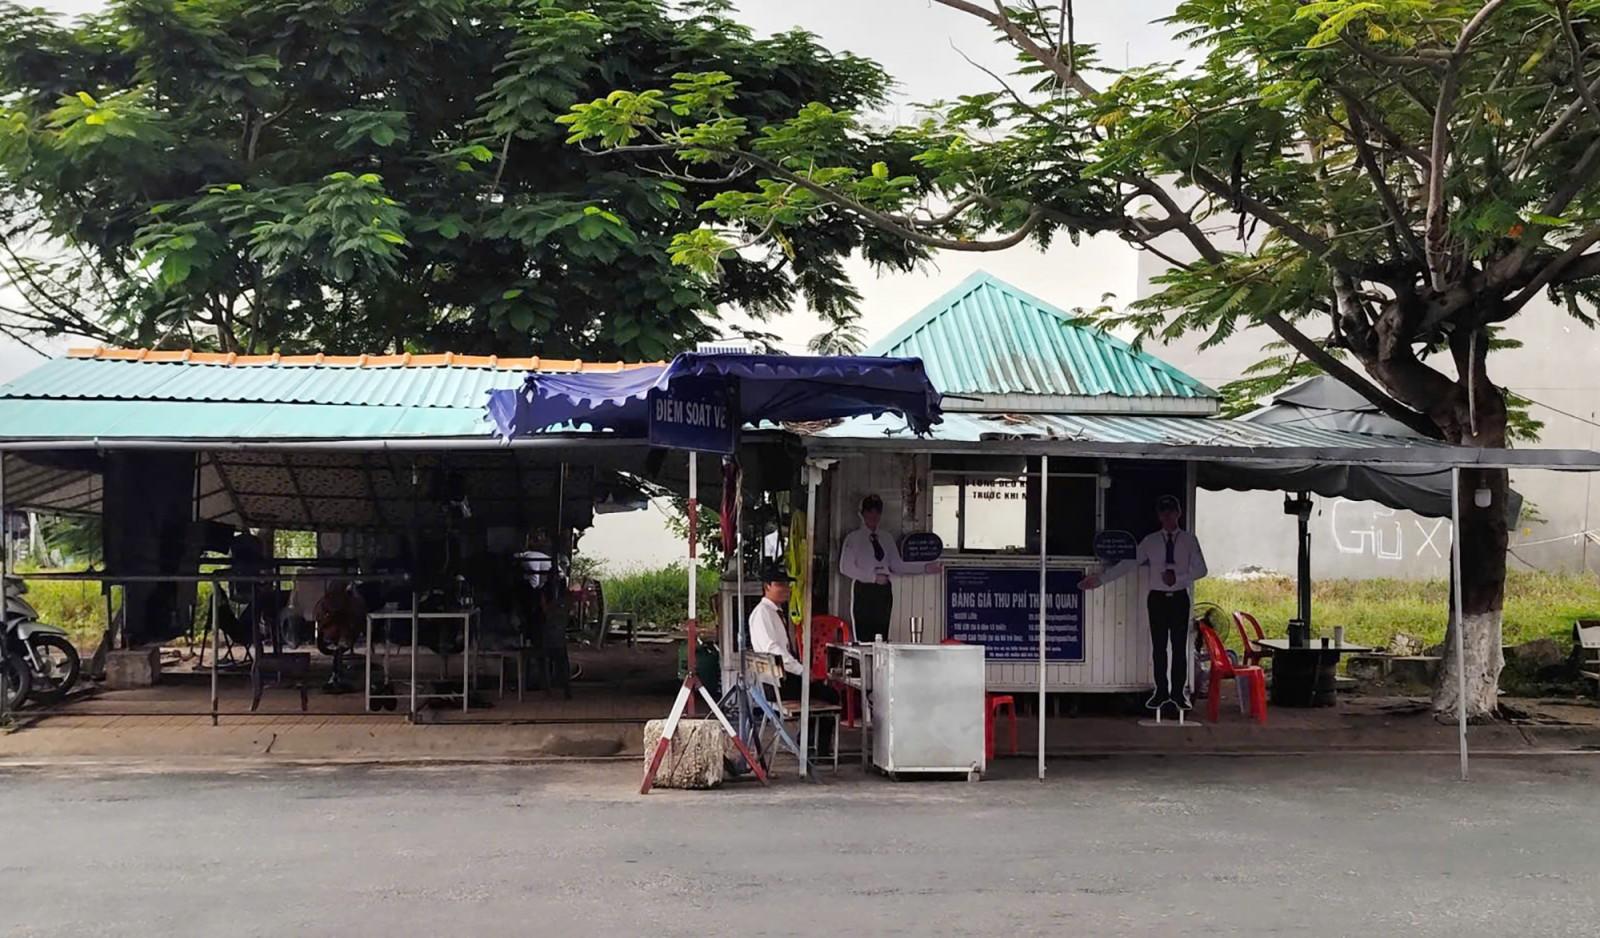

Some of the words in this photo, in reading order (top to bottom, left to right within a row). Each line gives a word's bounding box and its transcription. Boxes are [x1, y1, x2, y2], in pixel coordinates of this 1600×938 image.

[686, 397, 712, 428] SOÁT
[1004, 491, 1019, 500] KHI
[951, 587, 976, 609] BẢNG
[977, 589, 992, 609] GIÁ
[994, 592, 1011, 609] THU
[1012, 589, 1028, 609] PHÍ
[1028, 592, 1054, 609] THM
[1054, 593, 1079, 610] QUAN
